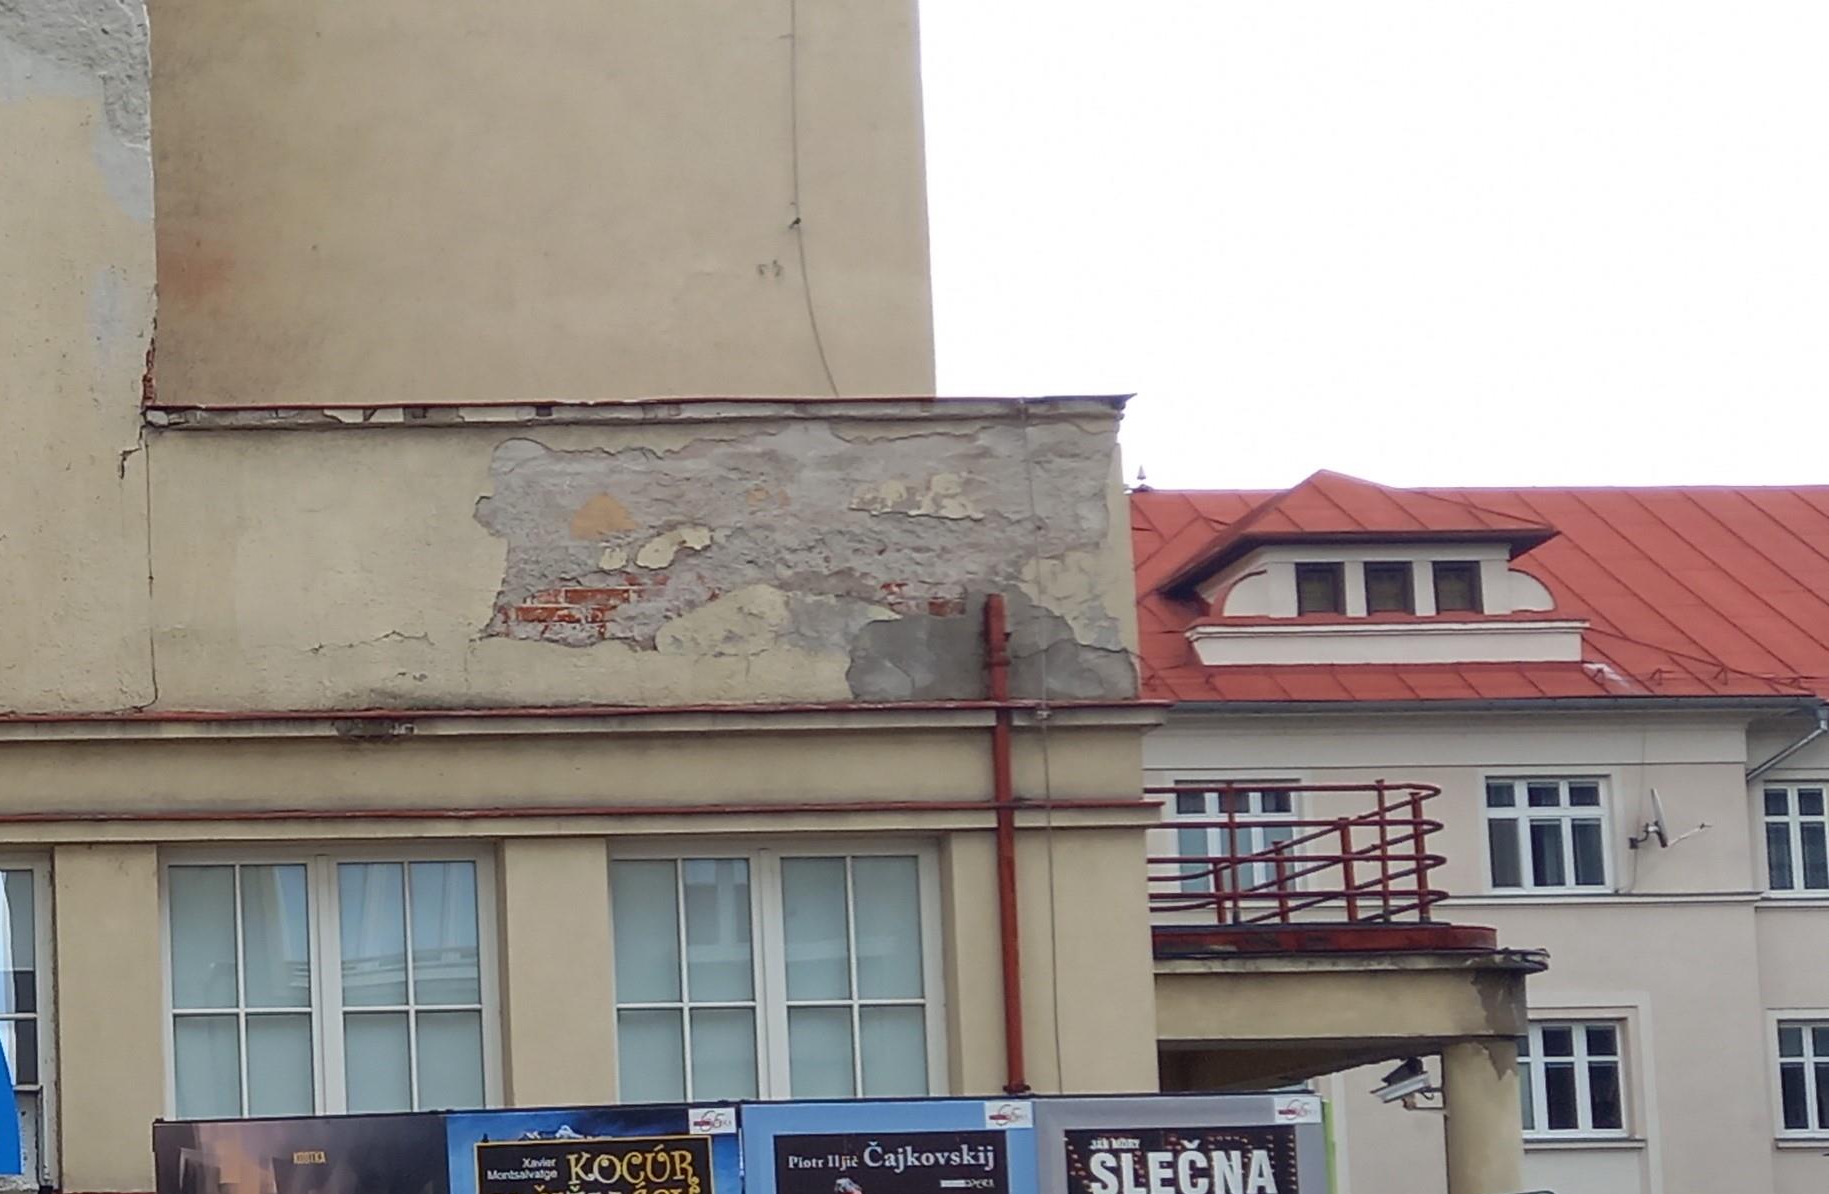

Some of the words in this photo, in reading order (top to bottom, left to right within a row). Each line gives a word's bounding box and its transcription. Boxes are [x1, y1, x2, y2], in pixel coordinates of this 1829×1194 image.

[521, 1156, 558, 1169] Xavier
[566, 1143, 702, 1187] KOCÚR
[863, 1140, 995, 1174] Čajkovskij
[487, 1168, 558, 1181] Montsalvatge
